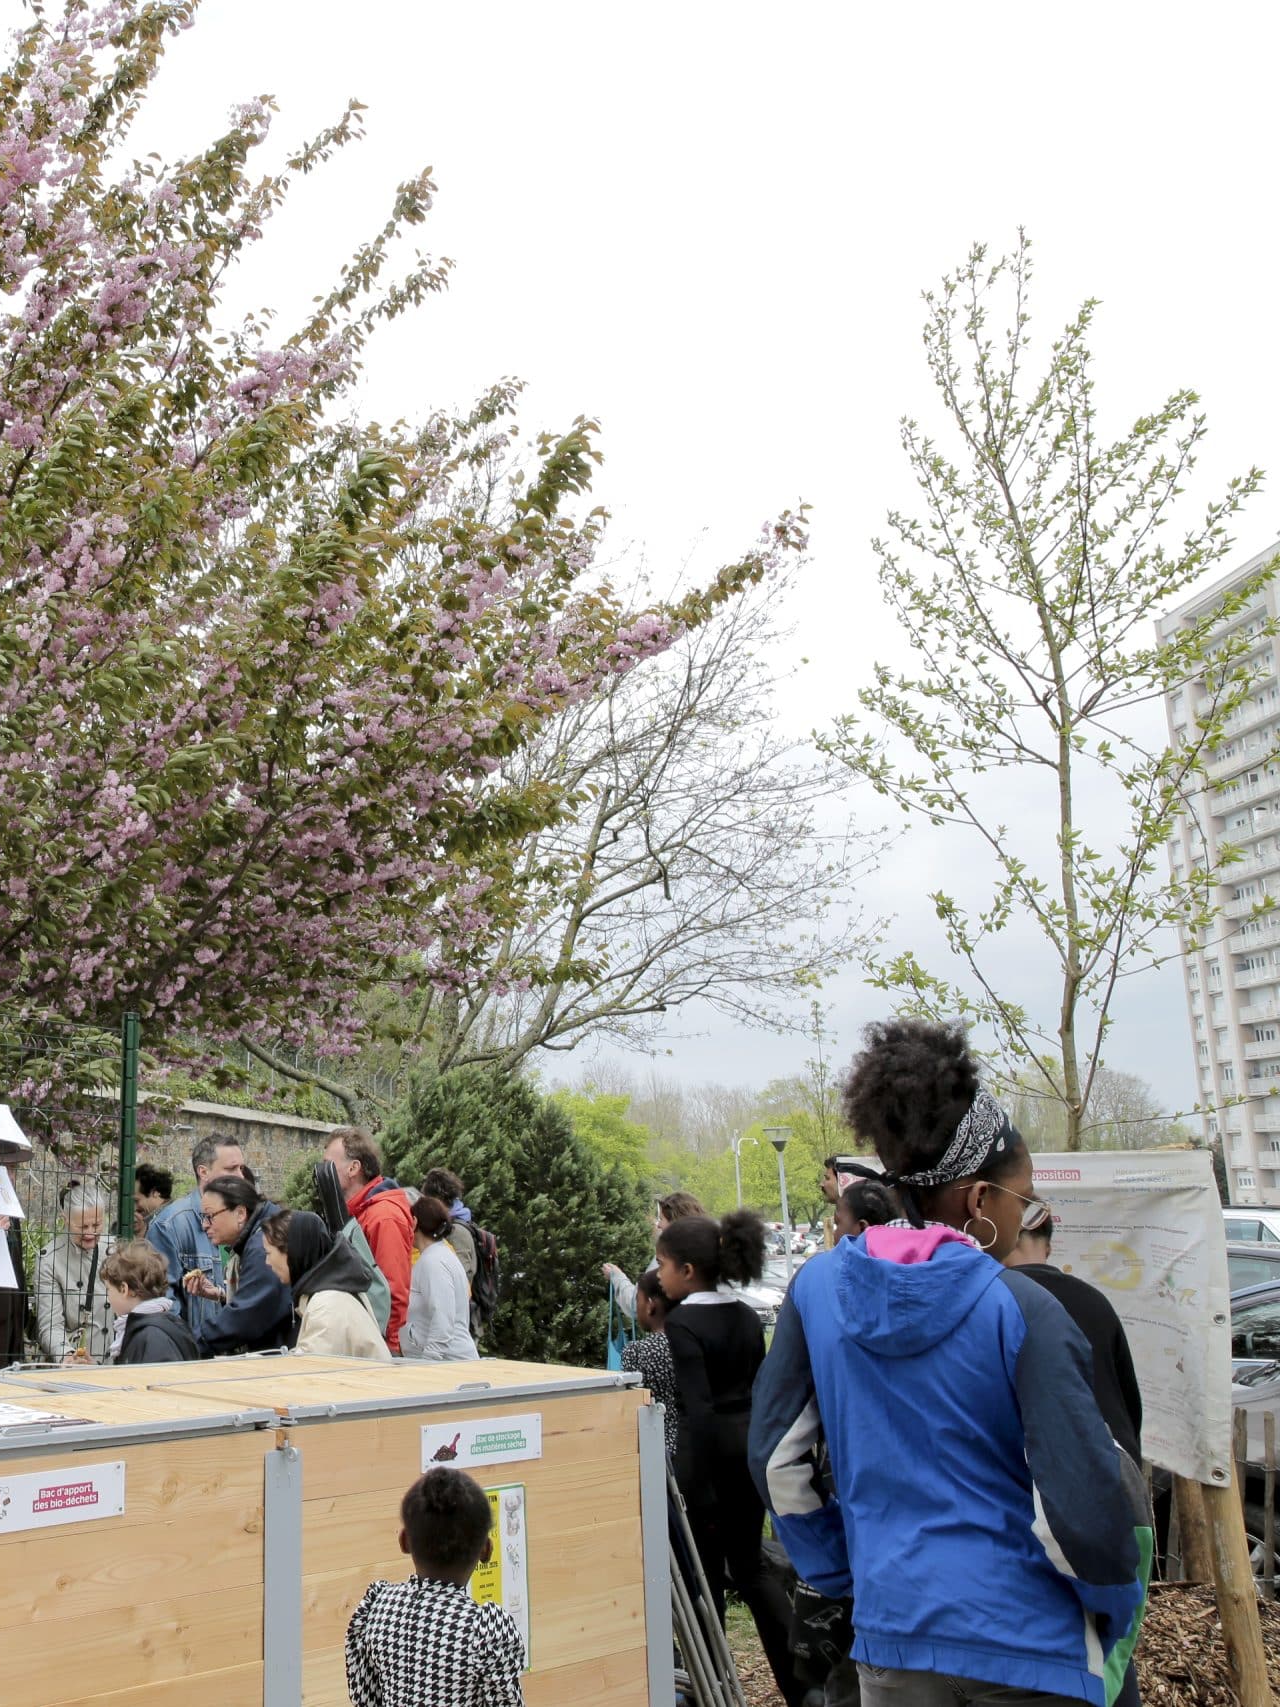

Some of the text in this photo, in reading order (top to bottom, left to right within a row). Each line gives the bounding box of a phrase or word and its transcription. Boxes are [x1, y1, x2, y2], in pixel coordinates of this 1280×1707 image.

[1032, 1170, 1079, 1180] sposition
[40, 1484, 90, 1498] Bac d'apport
[34, 1495, 97, 1511] des bio-déchets
